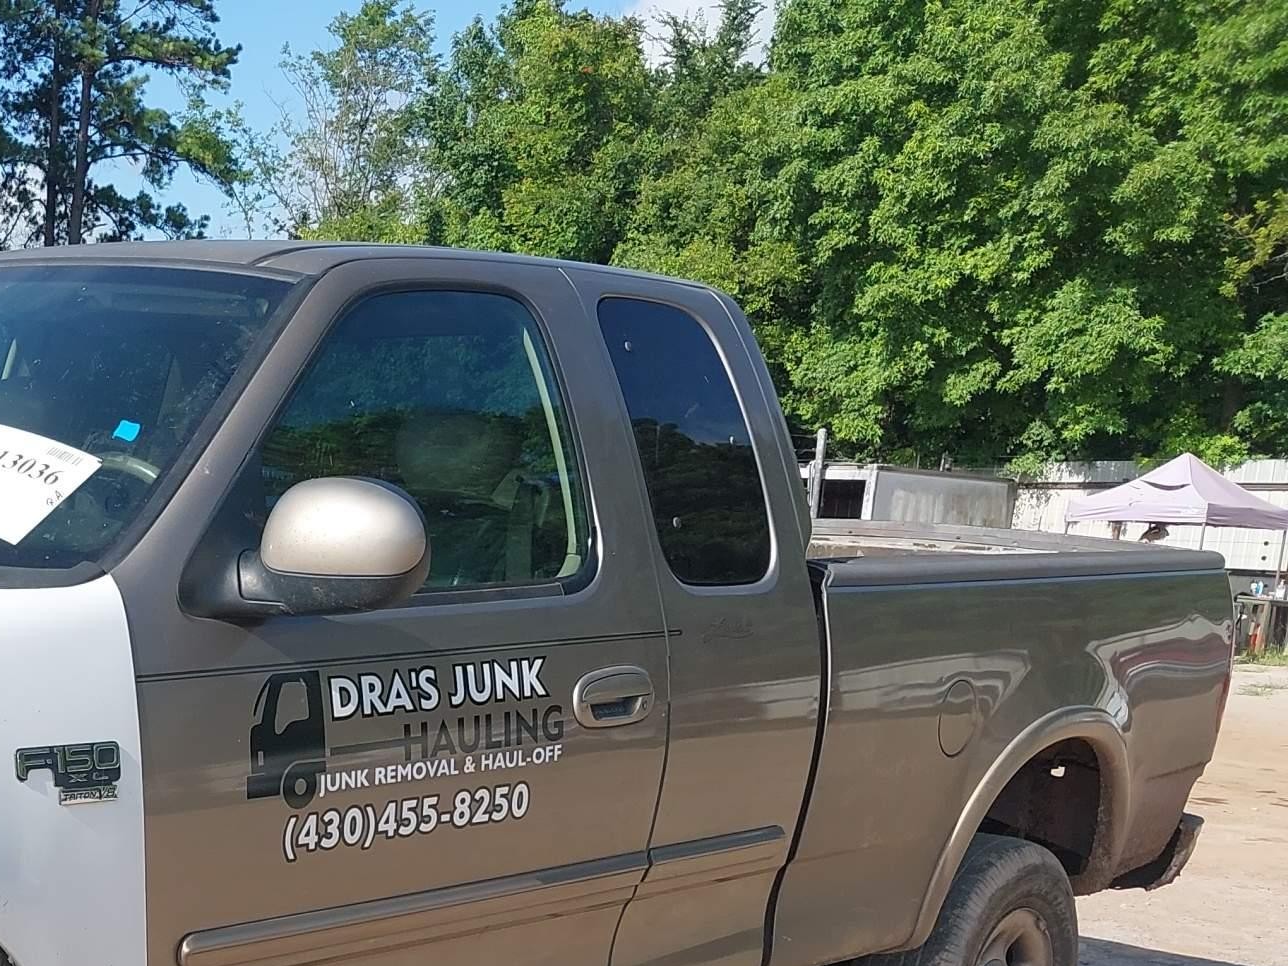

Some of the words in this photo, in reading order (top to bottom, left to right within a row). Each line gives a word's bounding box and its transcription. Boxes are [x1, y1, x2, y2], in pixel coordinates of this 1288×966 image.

[329, 666, 440, 721] DRA'S
[449, 656, 551, 708] JUNK
[403, 704, 564, 762] HAULING
[318, 769, 369, 798] JUNK
[374, 757, 459, 786] REMOVAL
[463, 755, 476, 773] &
[480, 744, 562, 771] HAUL-OFF
[283, 782, 531, 863] (430)455-8250
